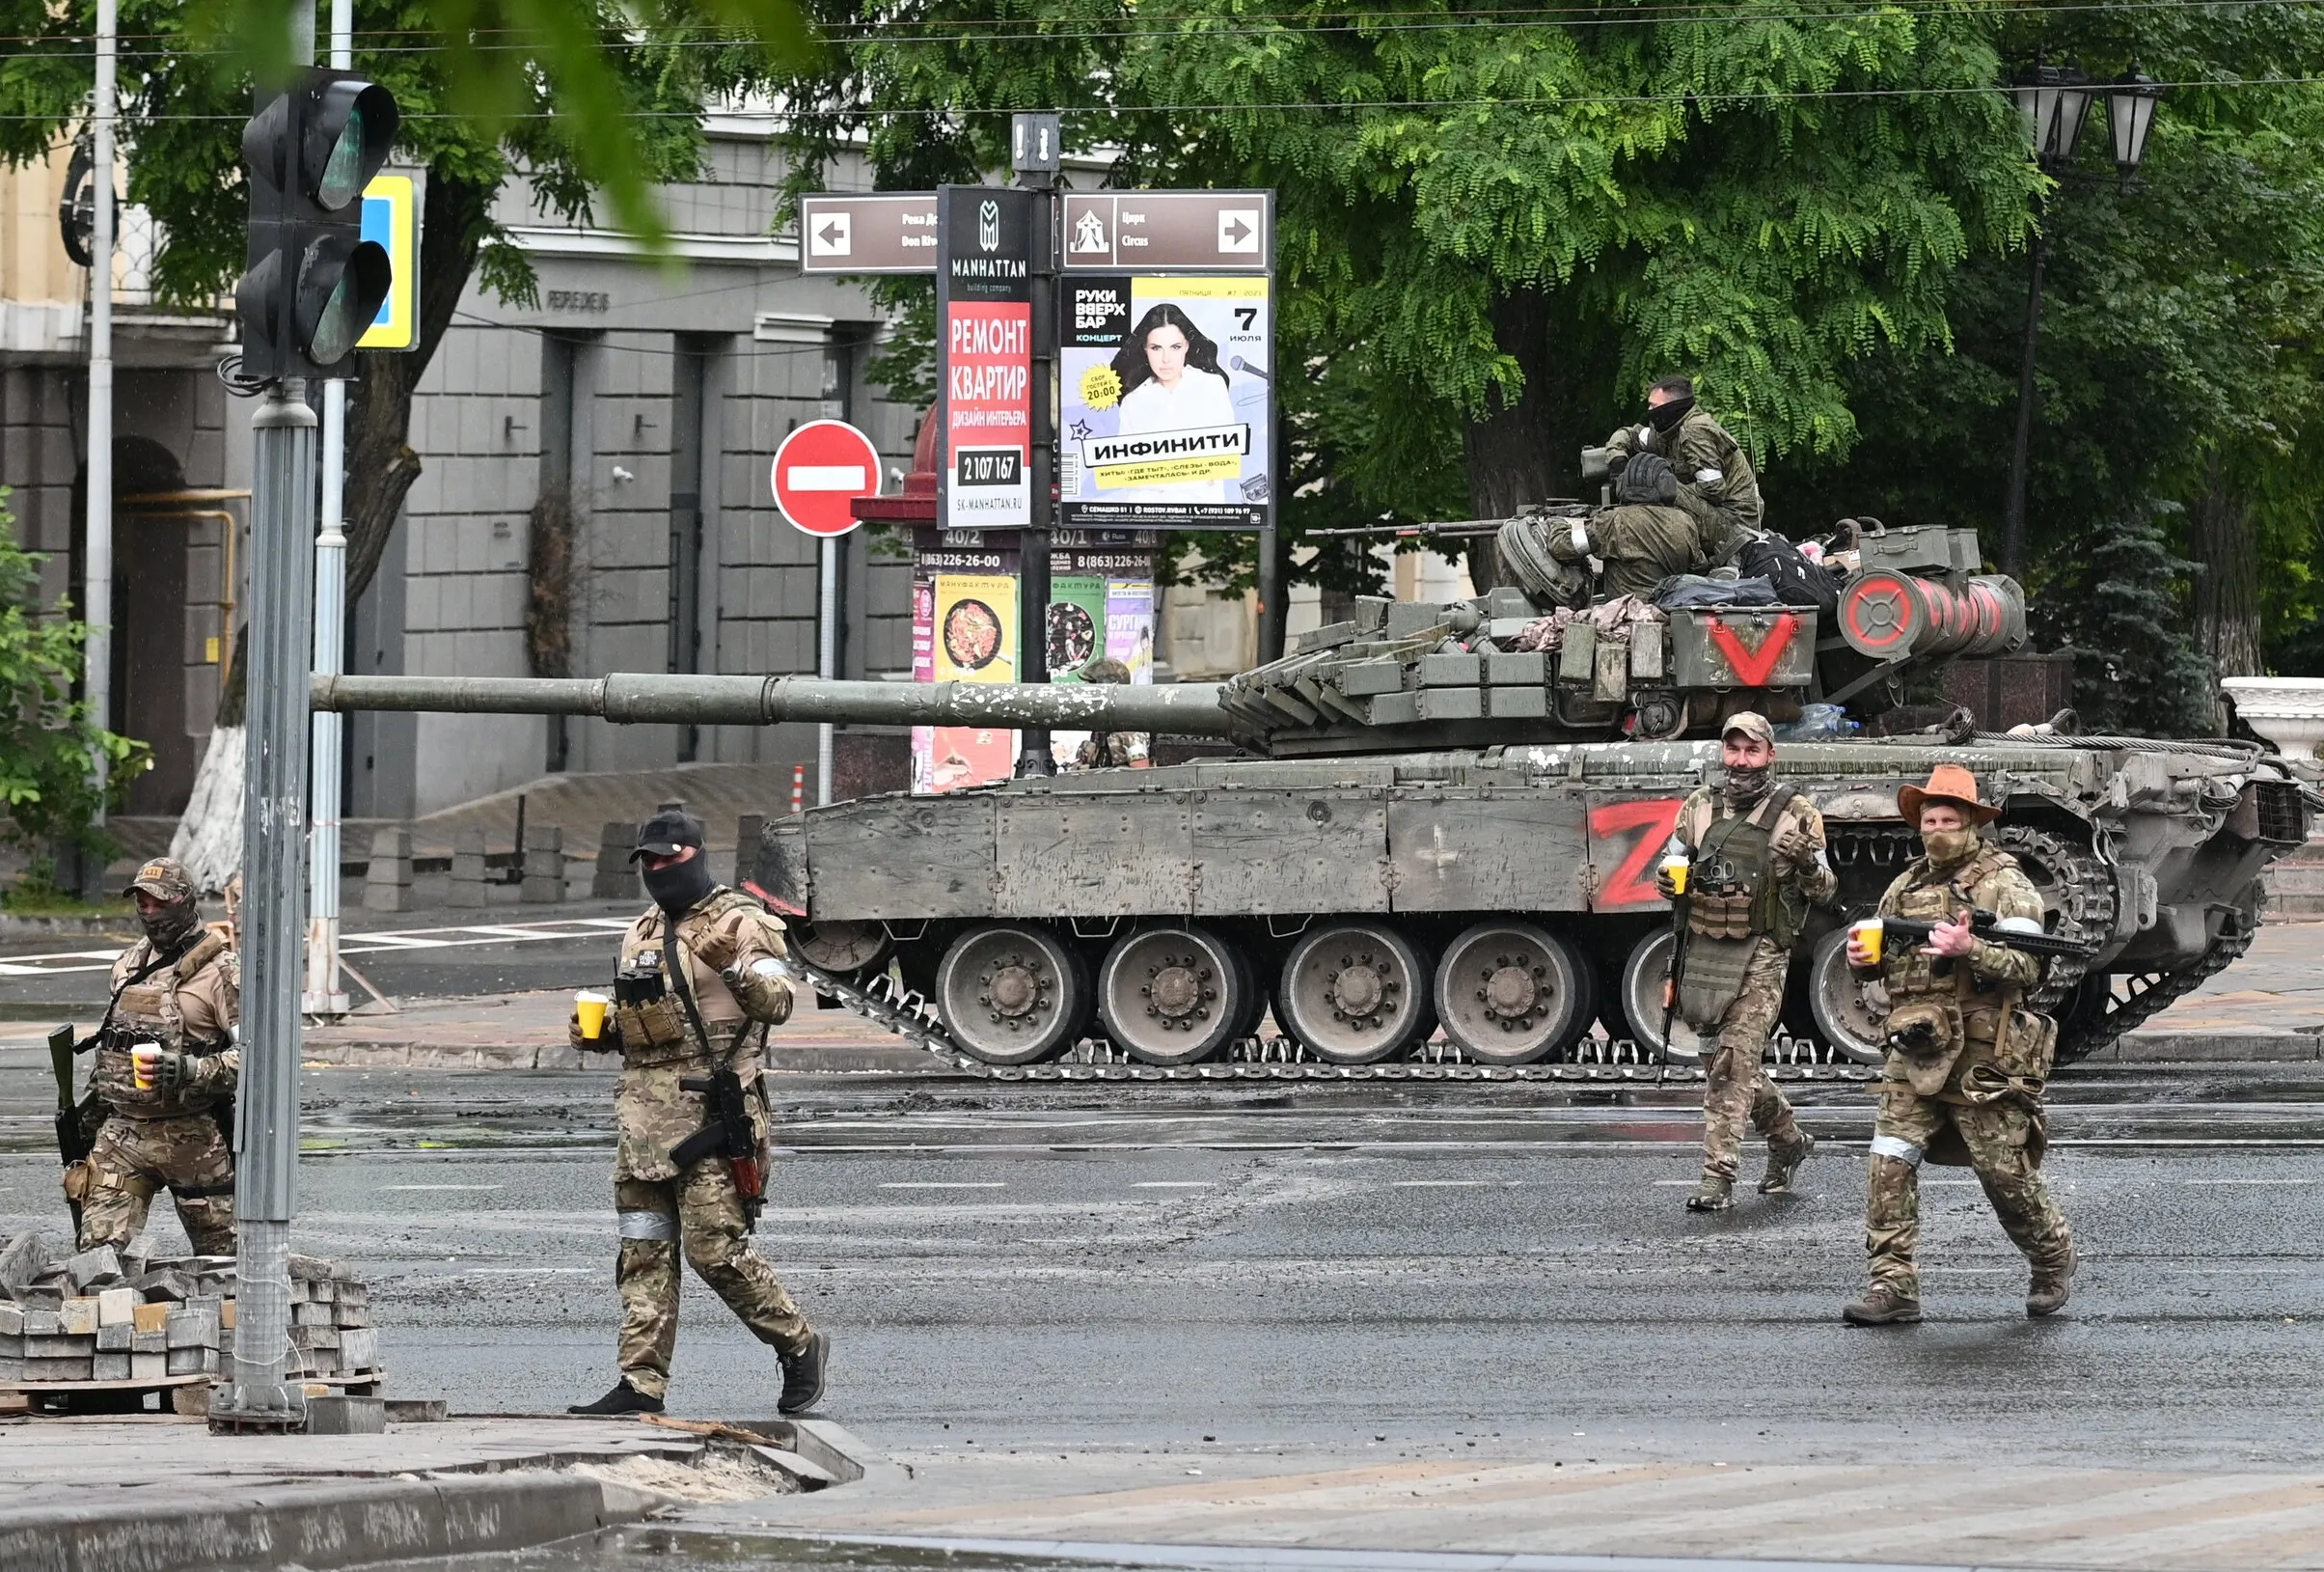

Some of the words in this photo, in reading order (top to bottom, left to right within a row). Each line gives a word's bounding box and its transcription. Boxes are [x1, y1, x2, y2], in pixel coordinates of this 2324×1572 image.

[902, 213, 925, 225] Река
[926, 212, 938, 227] До
[1122, 211, 1146, 226] Цирк
[901, 234, 920, 247] Don
[921, 234, 938, 247] Riv
[1121, 234, 1149, 247] Circus
[952, 259, 1025, 278] MANHATTAN
[967, 283, 989, 293] building
[989, 285, 1012, 293] company
[1076, 290, 1117, 303] РУКИ
[1076, 302, 1126, 317] ВВЕРХ
[1076, 316, 1107, 329] БАР
[1234, 308, 1258, 331] 7
[951, 318, 1027, 355] РЕМОНТ
[1076, 334, 1123, 343] КОНЦЕРТ
[951, 365, 1027, 400] КВАРТИР
[1086, 386, 1116, 400] 20:00
[952, 407, 985, 429] ДИЗАЙН
[986, 410, 1027, 427] ИНТЕРЬЕРА
[1094, 432, 1240, 460] ИНФИНИТИ
[957, 497, 1023, 511] SK-MANHATTAN.RU
[945, 529, 981, 545] 40/2
[1050, 529, 1087, 546] 40/1
[1706, 612, 1799, 687] V
[1591, 798, 1684, 904] Z
